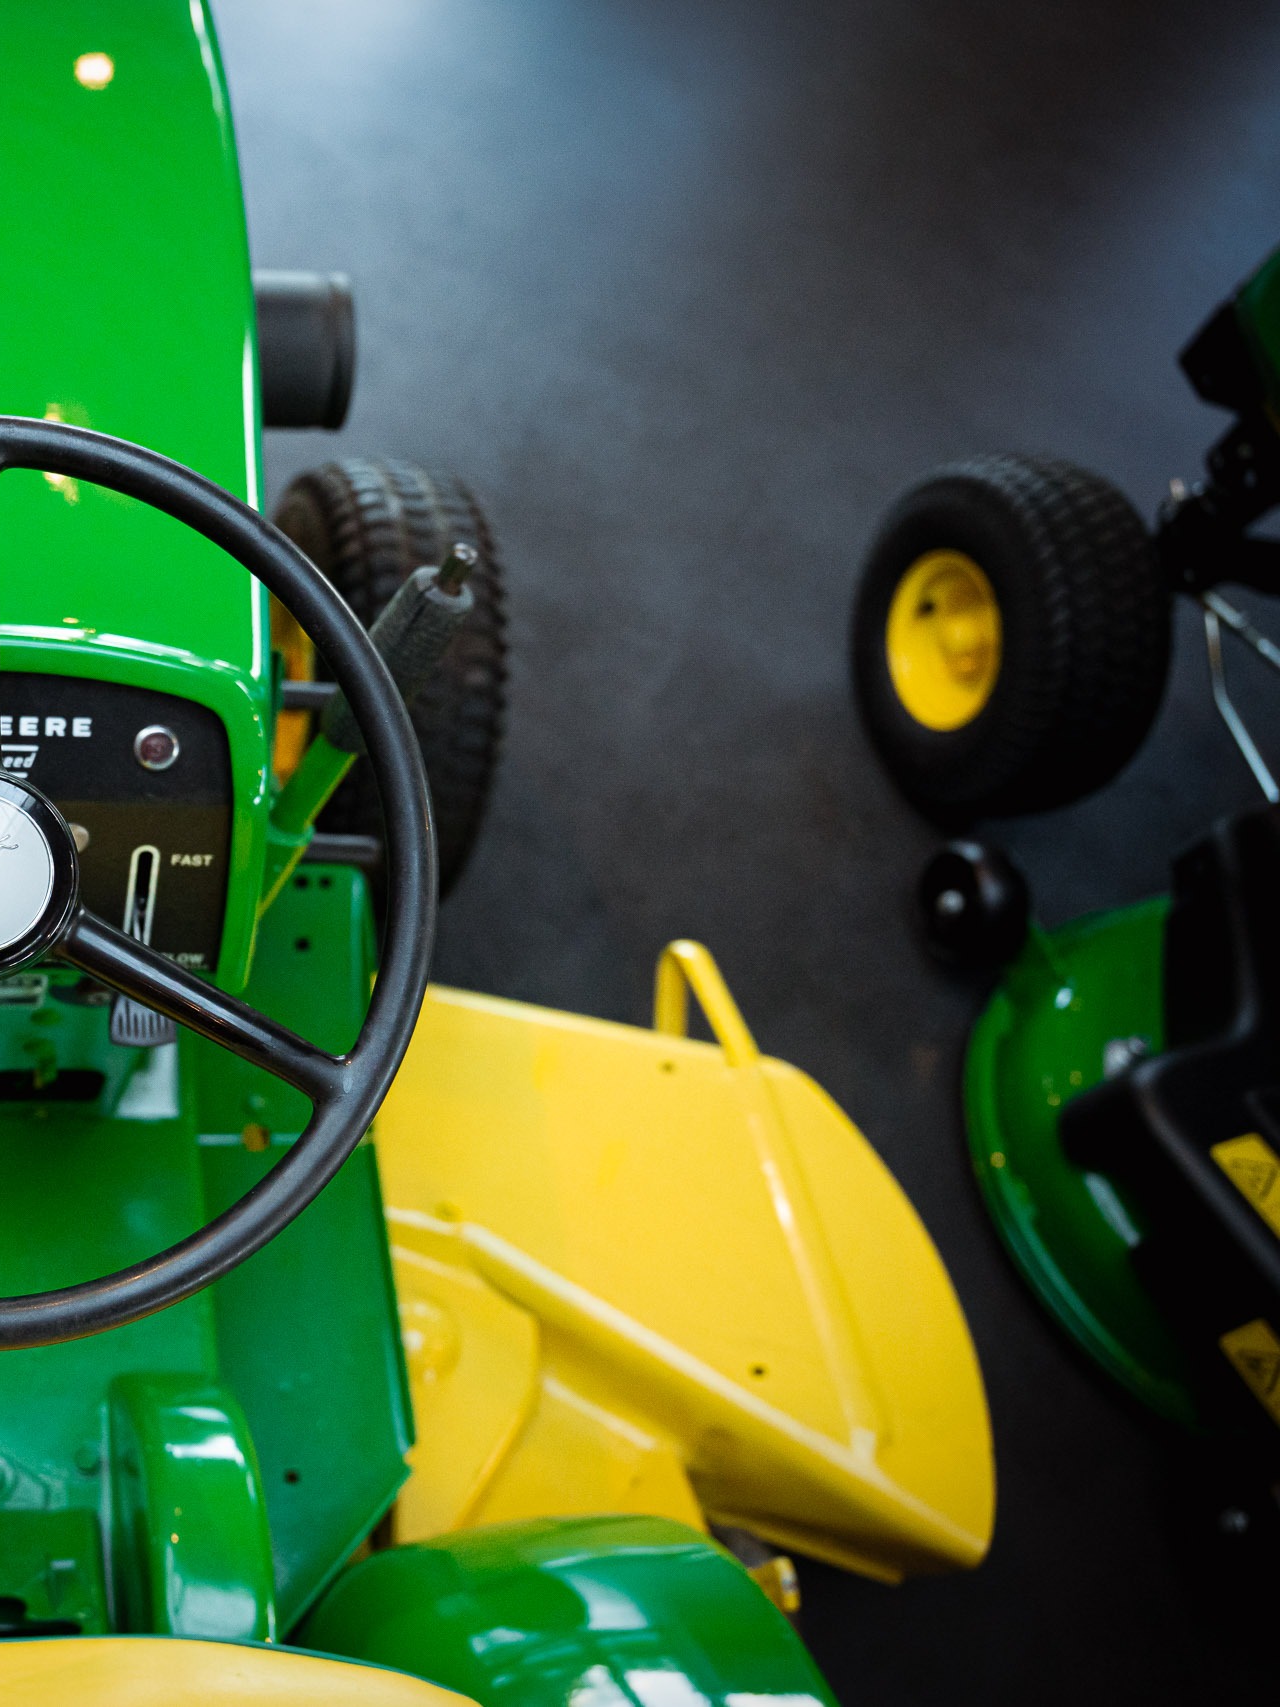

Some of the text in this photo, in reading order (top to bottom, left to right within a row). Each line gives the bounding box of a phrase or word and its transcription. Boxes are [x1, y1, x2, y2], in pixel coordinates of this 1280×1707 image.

[0, 715, 92, 737] EERE
[2, 752, 37, 769] eed
[170, 853, 213, 867] FAST
[161, 952, 205, 965] LOW
